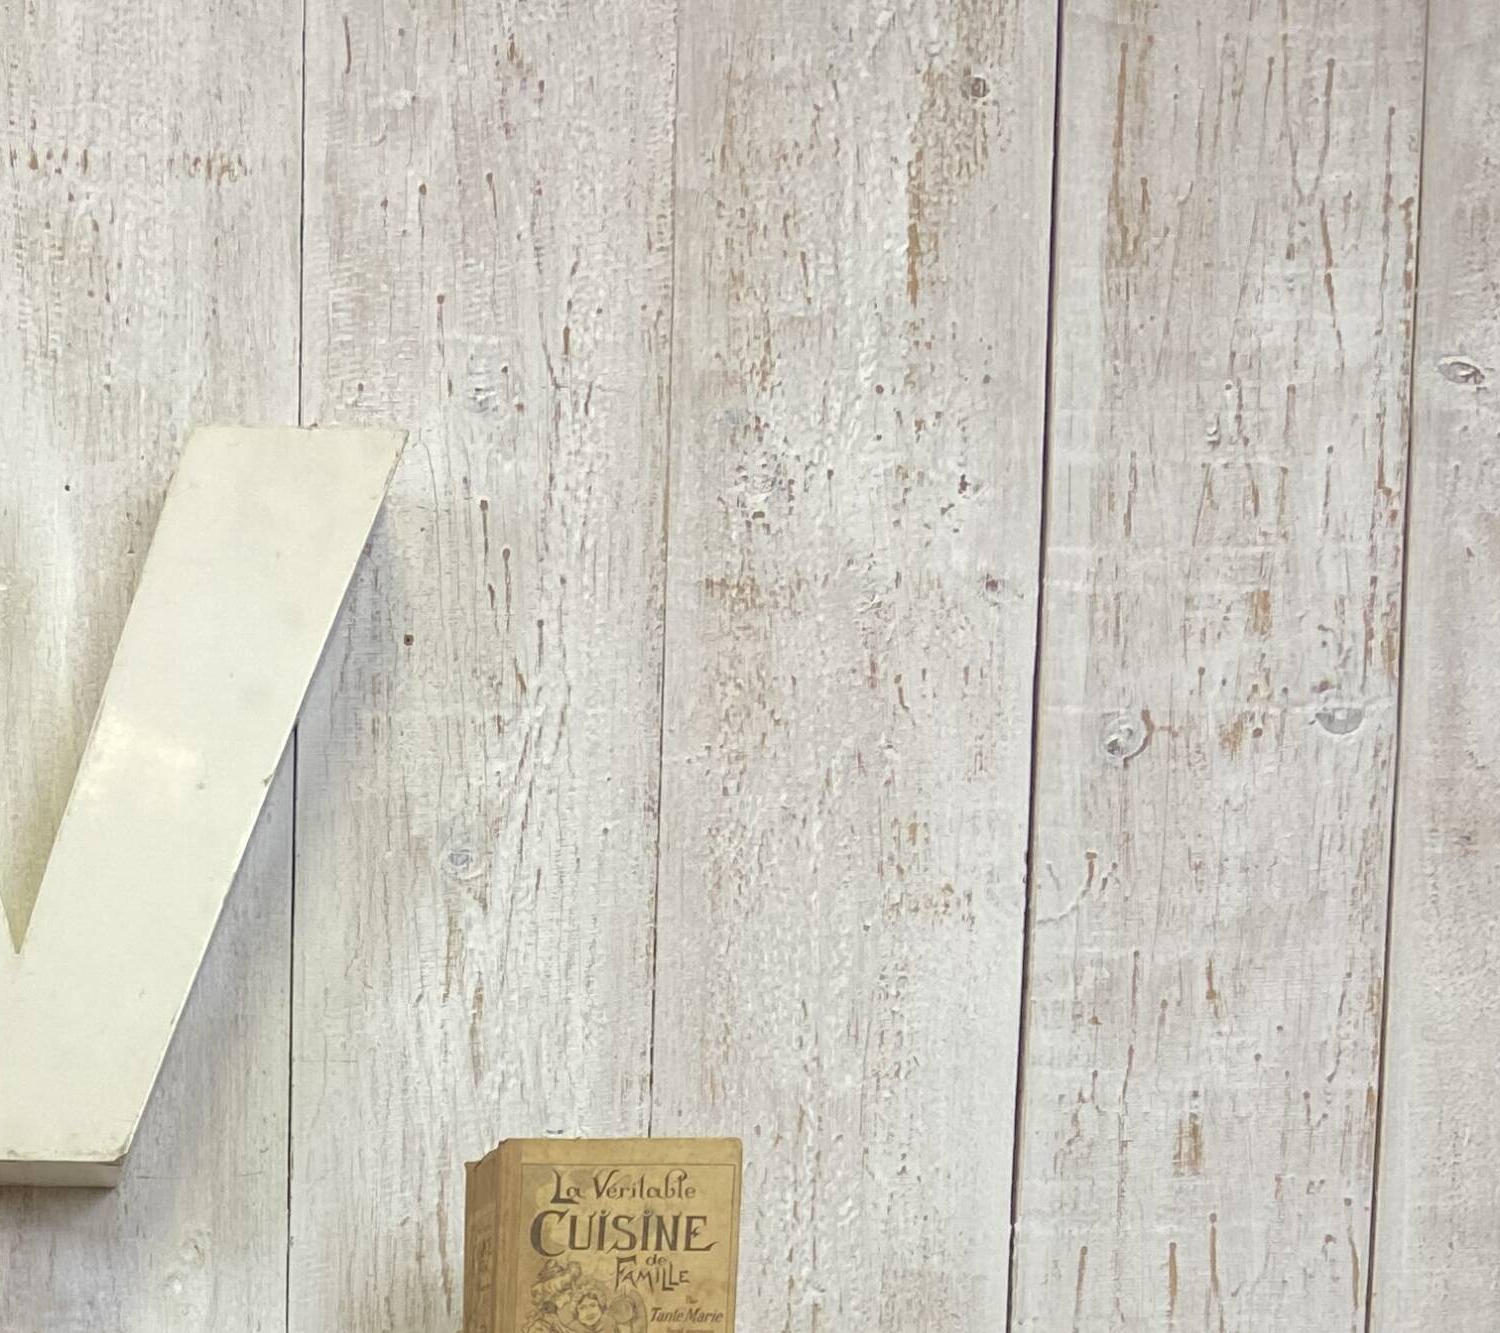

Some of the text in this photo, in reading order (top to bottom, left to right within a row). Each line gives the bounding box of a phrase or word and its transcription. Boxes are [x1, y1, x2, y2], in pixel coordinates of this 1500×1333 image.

[550, 1167, 584, 1205] La
[529, 1208, 720, 1258] CUISINE
[614, 1255, 691, 1293] FAMILLE
[645, 1254, 668, 1266] de
[684, 1307, 724, 1323] Marie
